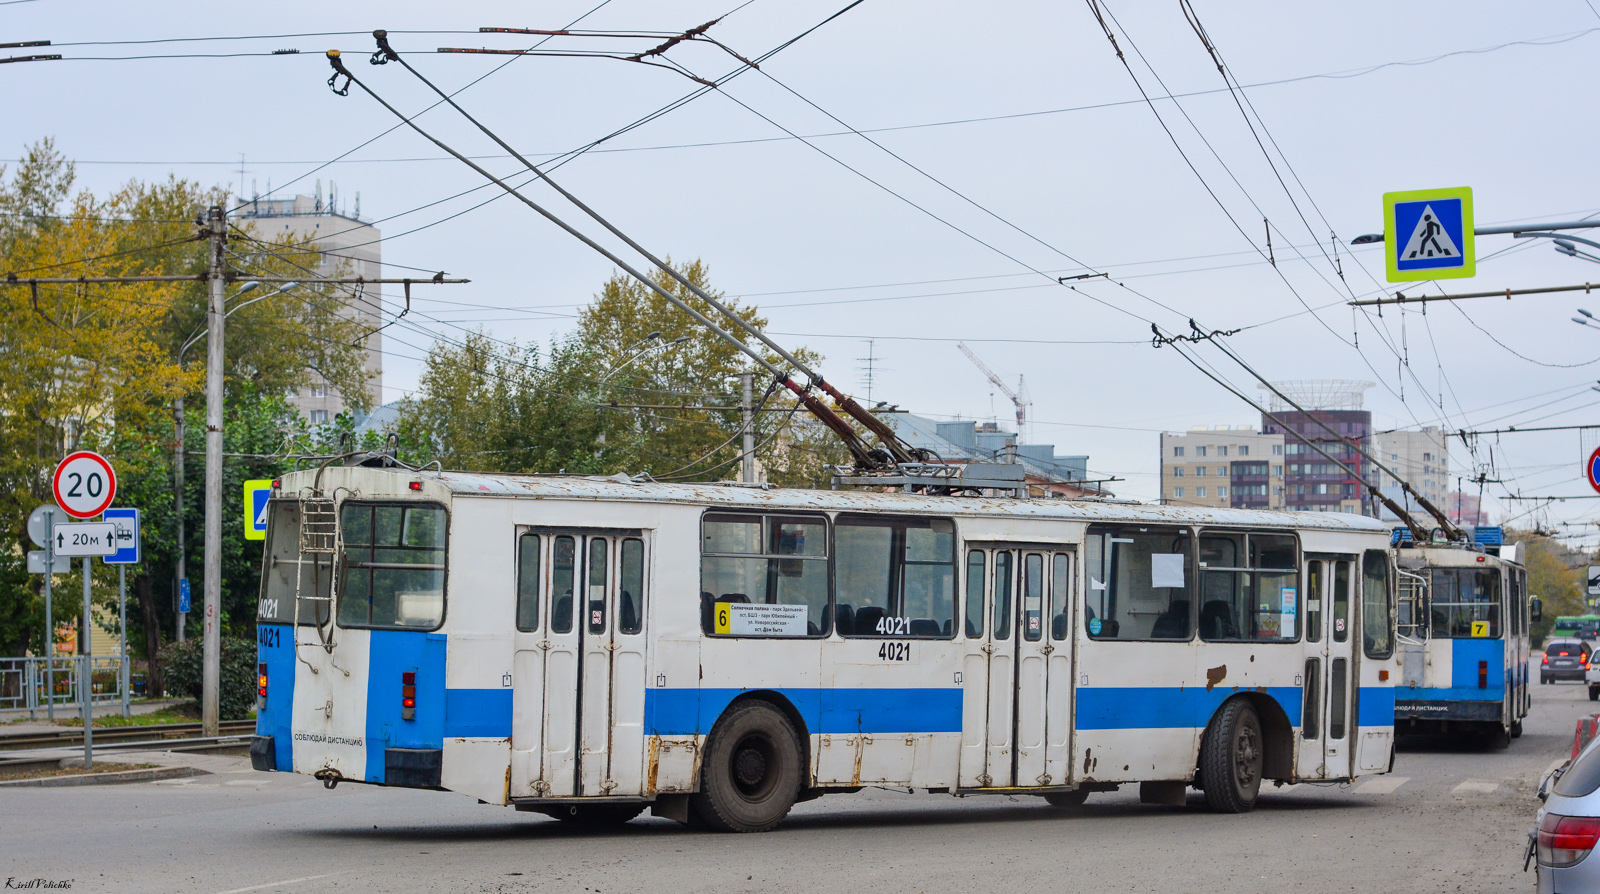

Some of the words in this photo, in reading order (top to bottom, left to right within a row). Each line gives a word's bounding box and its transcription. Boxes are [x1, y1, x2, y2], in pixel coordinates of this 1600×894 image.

[67, 472, 102, 498] 20
[258, 598, 278, 618] 4021
[719, 610, 727, 626] 6
[876, 616, 910, 634] 4021
[260, 628, 280, 648] 4021
[1476, 625, 1483, 634] 7
[879, 642, 910, 661] 4021
[294, 734, 326, 742] СОБЛЮДАЙ
[328, 736, 362, 746] ДИСТАНЦИЮ
